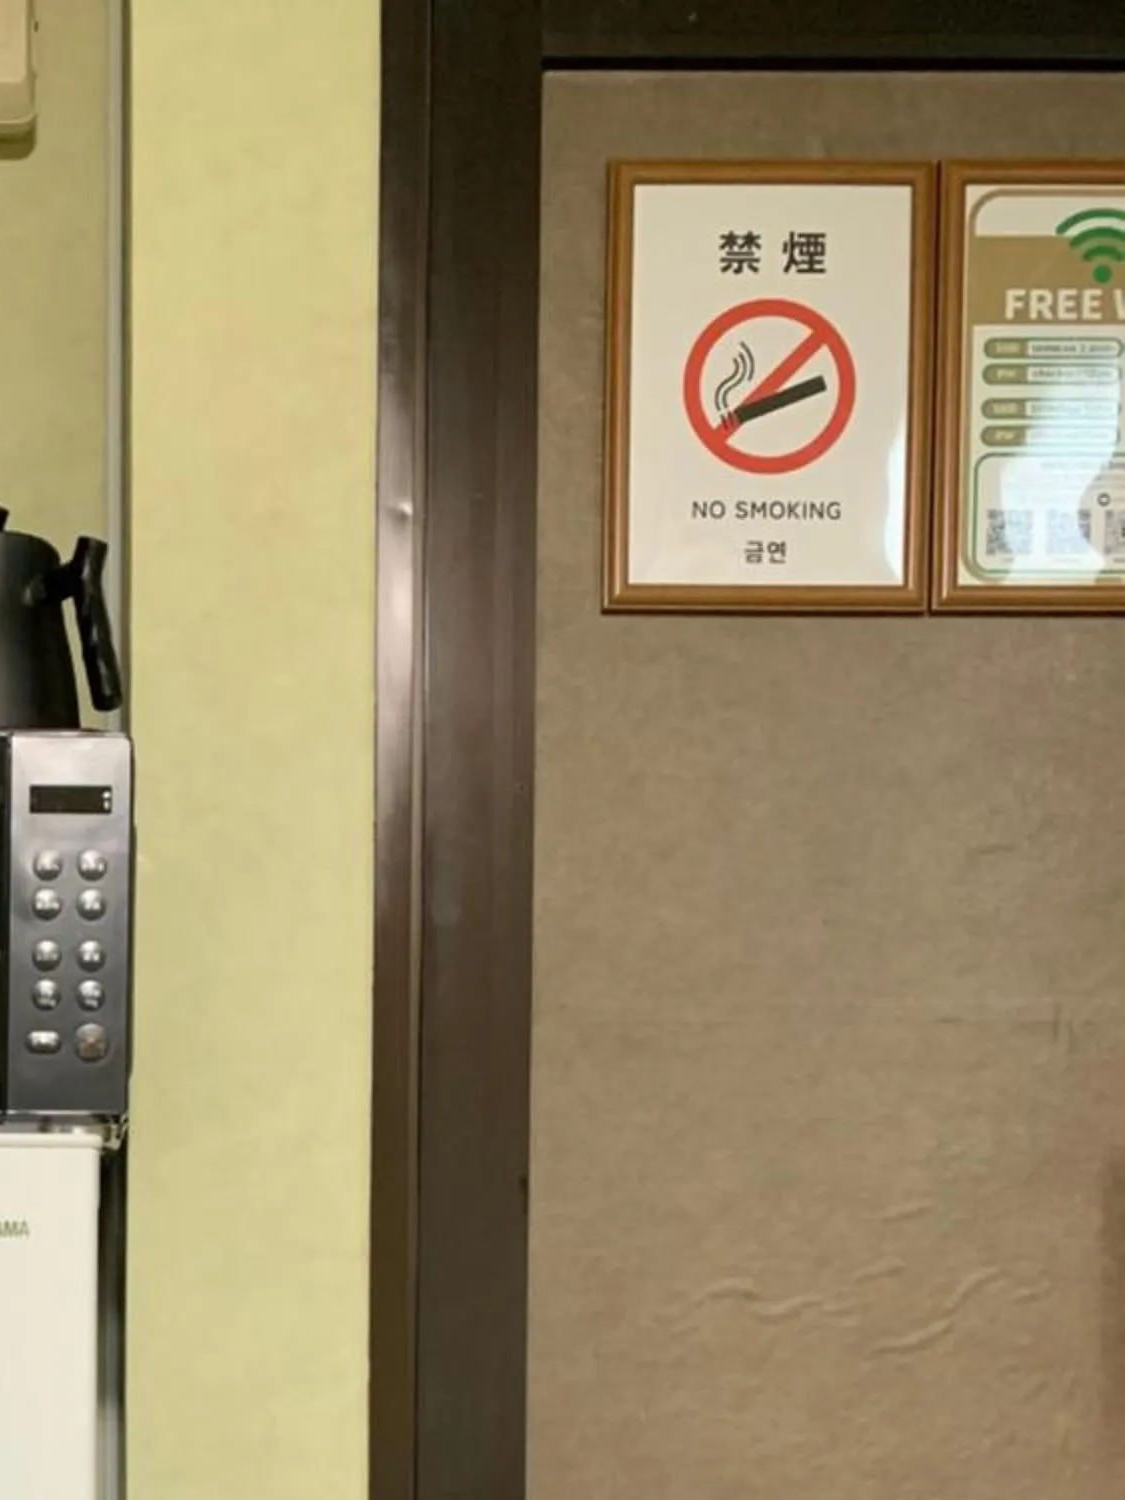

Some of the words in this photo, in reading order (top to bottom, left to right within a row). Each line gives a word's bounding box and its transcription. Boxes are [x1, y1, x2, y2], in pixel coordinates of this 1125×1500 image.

[1004, 288, 1104, 321] FREE
[691, 499, 726, 519] NO
[735, 500, 842, 520] SMOKING
[744, 539, 787, 564] 금연
